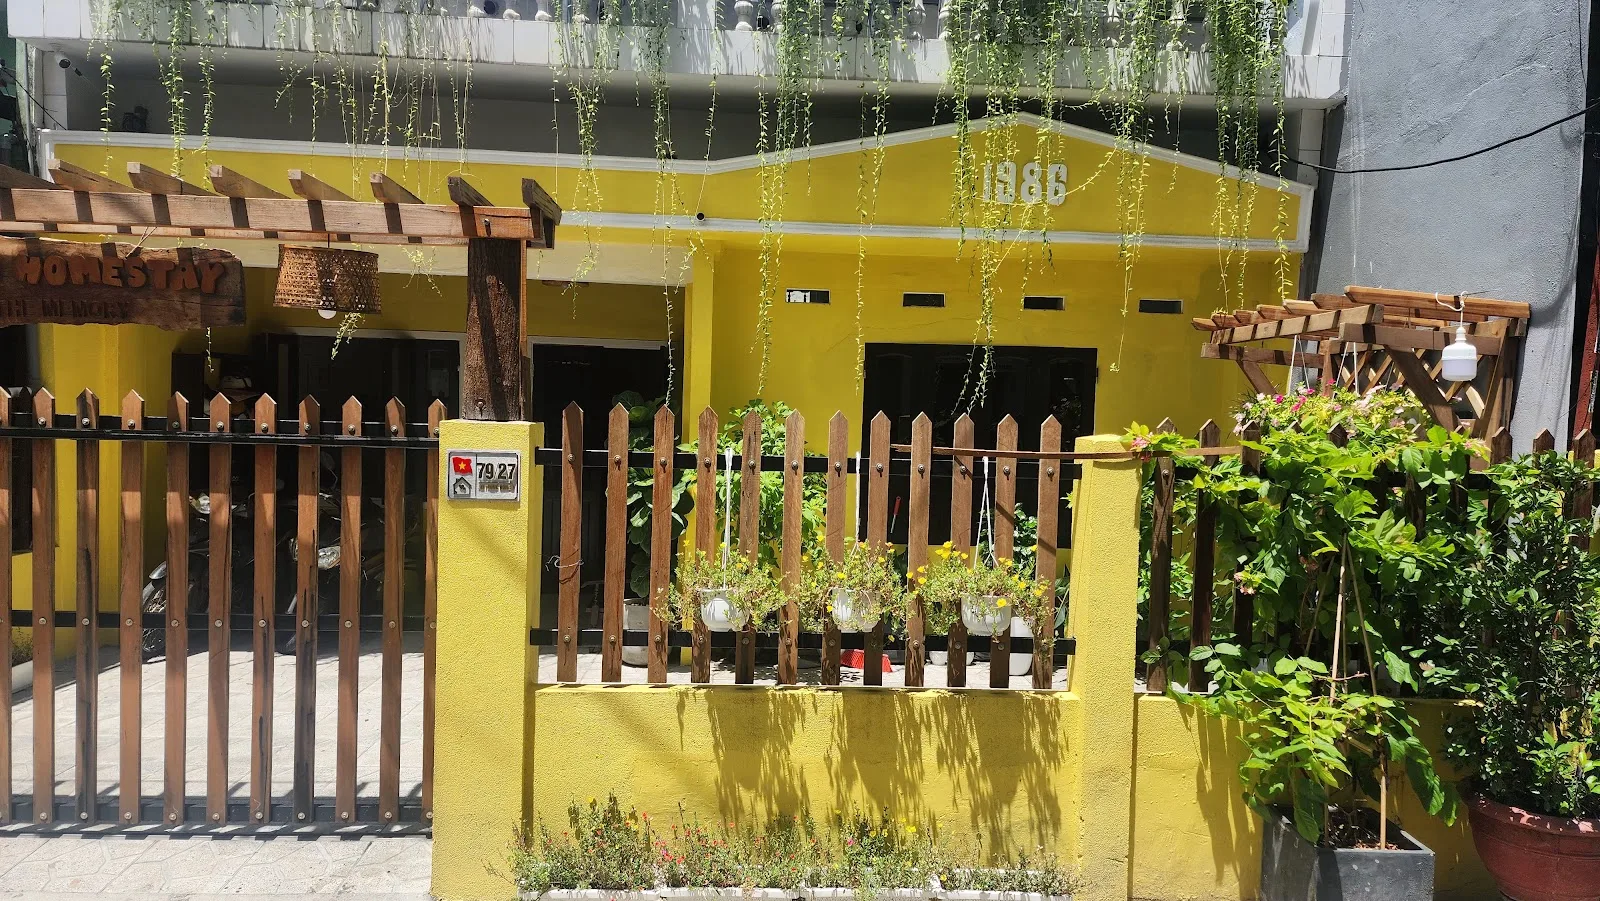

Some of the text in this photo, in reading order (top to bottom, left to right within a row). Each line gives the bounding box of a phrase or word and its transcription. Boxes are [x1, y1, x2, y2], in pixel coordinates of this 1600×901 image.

[983, 161, 1067, 206] 1986
[15, 252, 225, 294] HOMESTAY
[41, 299, 131, 319] MEMORY
